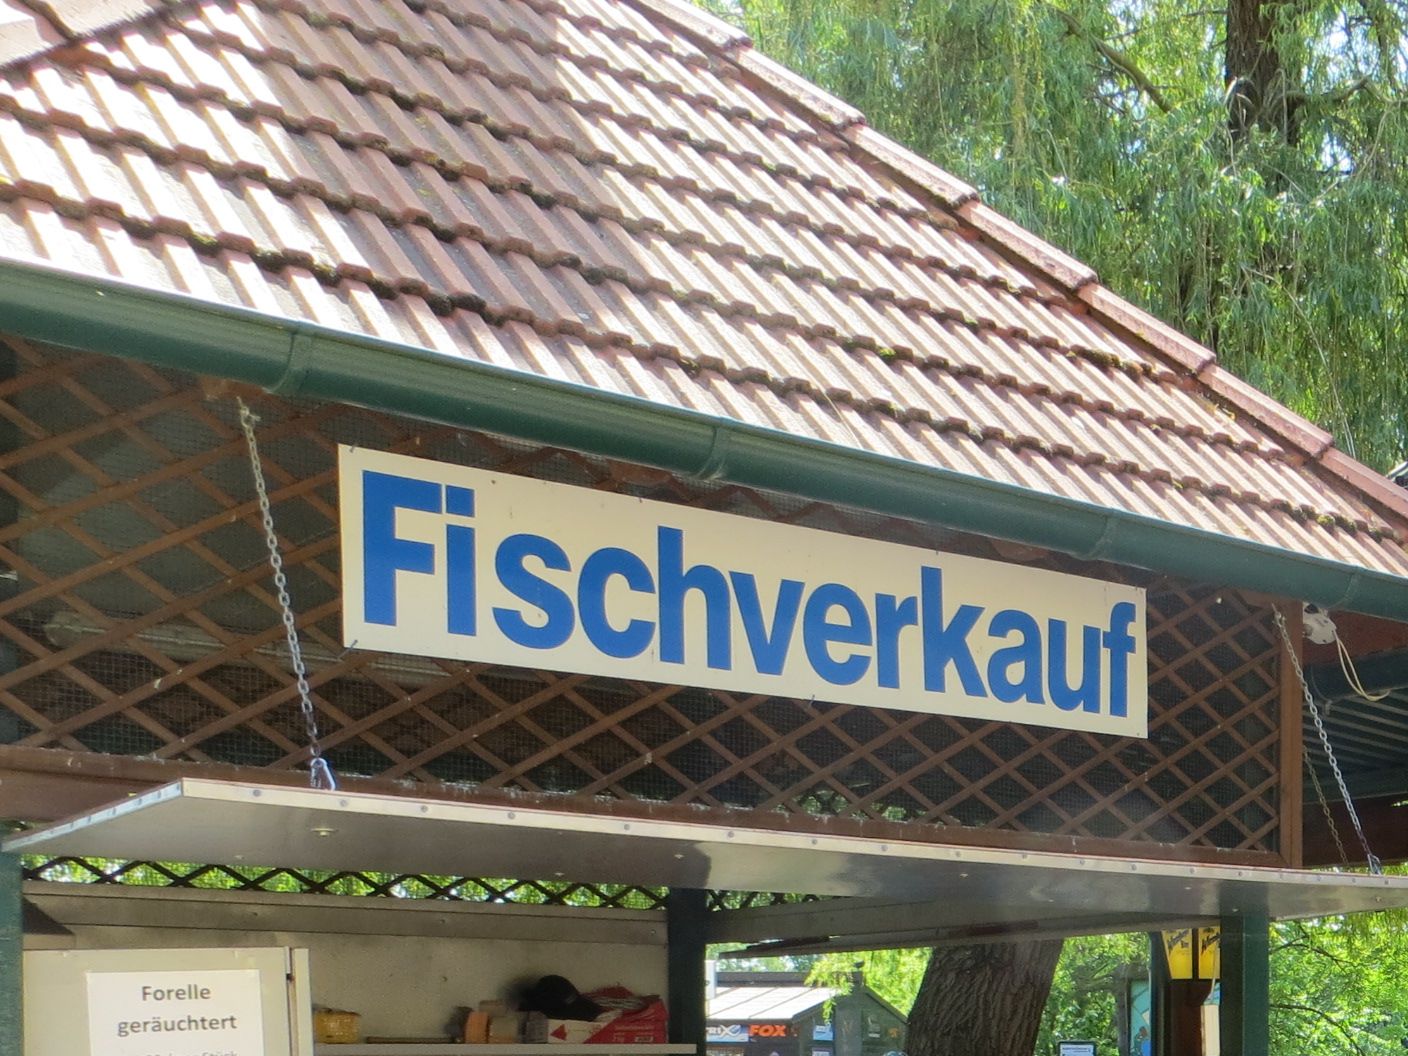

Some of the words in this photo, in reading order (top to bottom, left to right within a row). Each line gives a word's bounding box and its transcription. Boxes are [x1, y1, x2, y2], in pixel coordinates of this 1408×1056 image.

[362, 469, 1137, 718] Fischverkauf
[141, 984, 212, 1001] Forelle
[117, 1014, 237, 1037] geräuchtert
[750, 1025, 786, 1037] FOX
